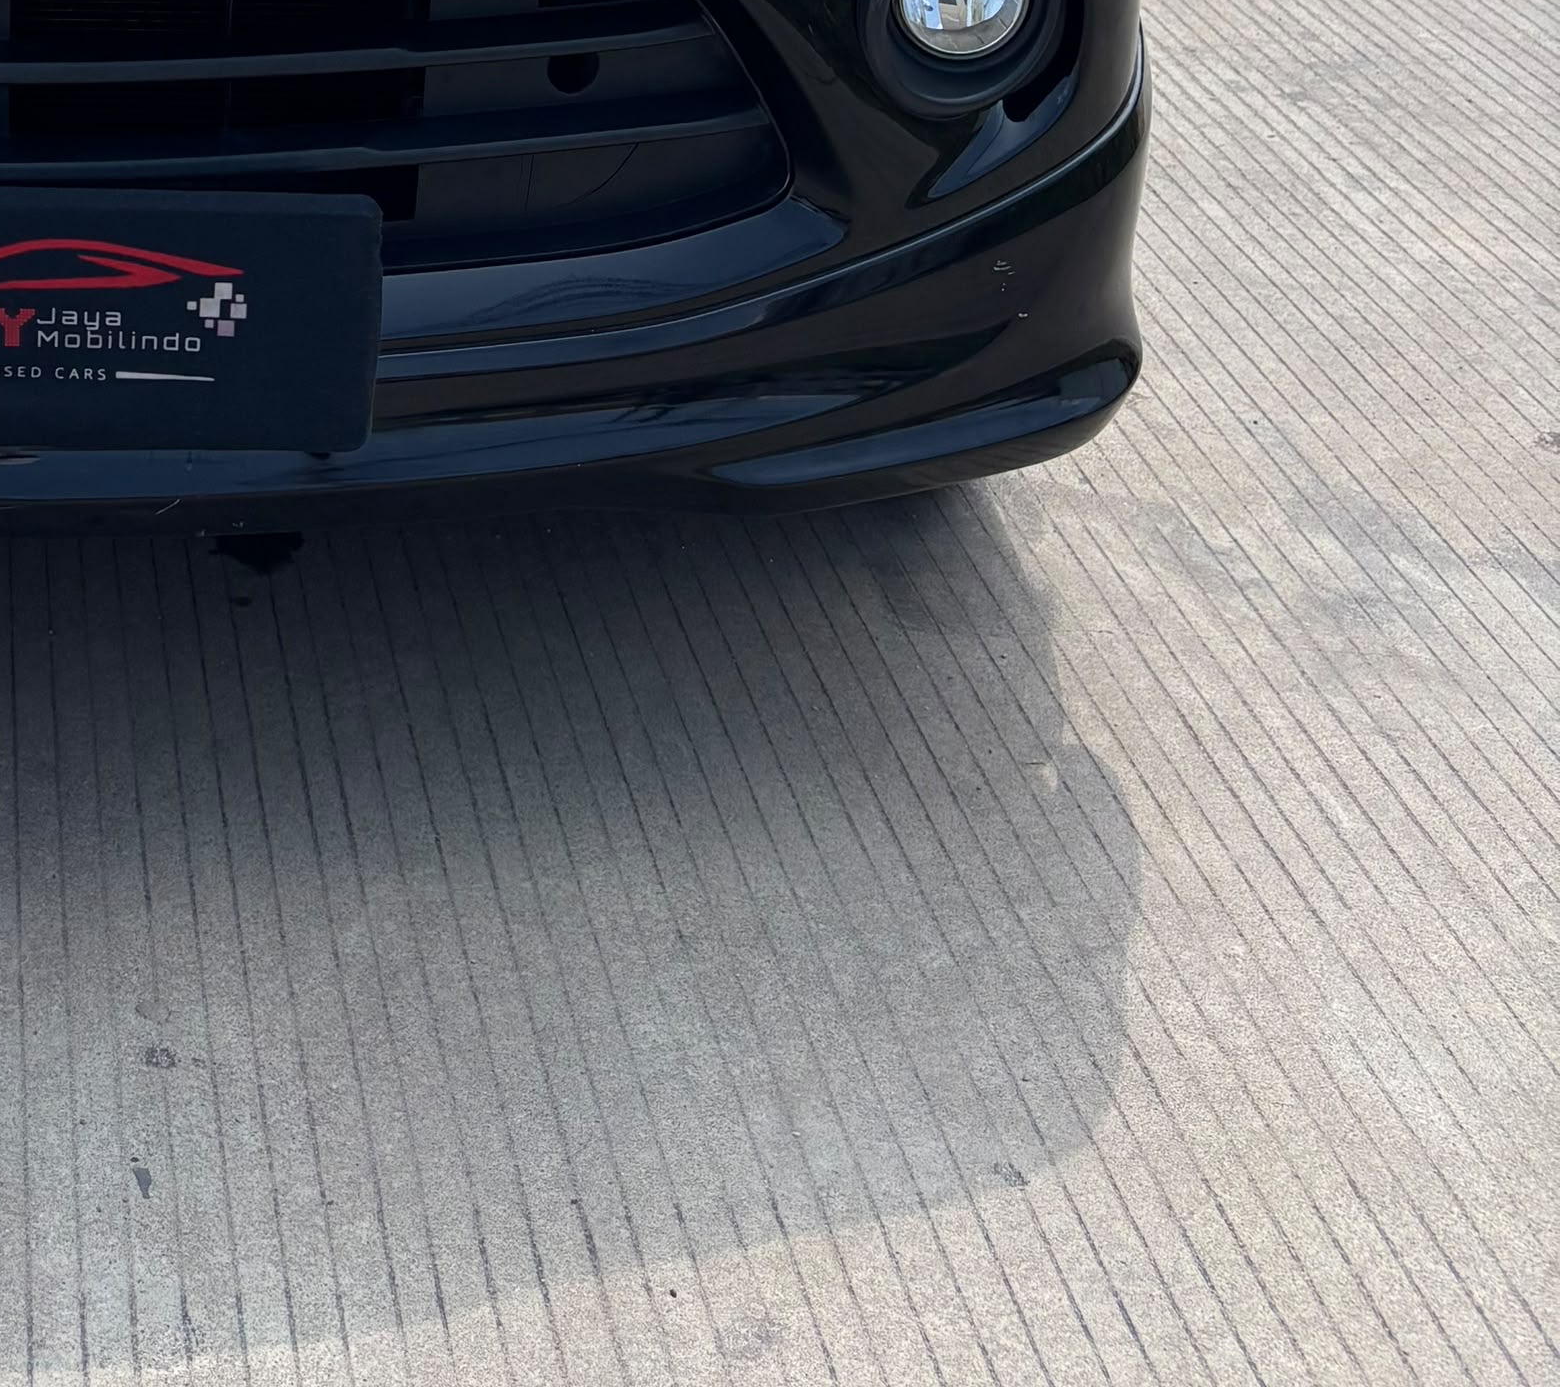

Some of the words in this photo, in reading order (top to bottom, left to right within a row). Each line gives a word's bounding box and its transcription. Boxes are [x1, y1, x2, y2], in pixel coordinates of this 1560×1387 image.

[37, 307, 122, 330] Jaya
[37, 329, 201, 352] Mobilindo
[54, 367, 107, 381] CARS
